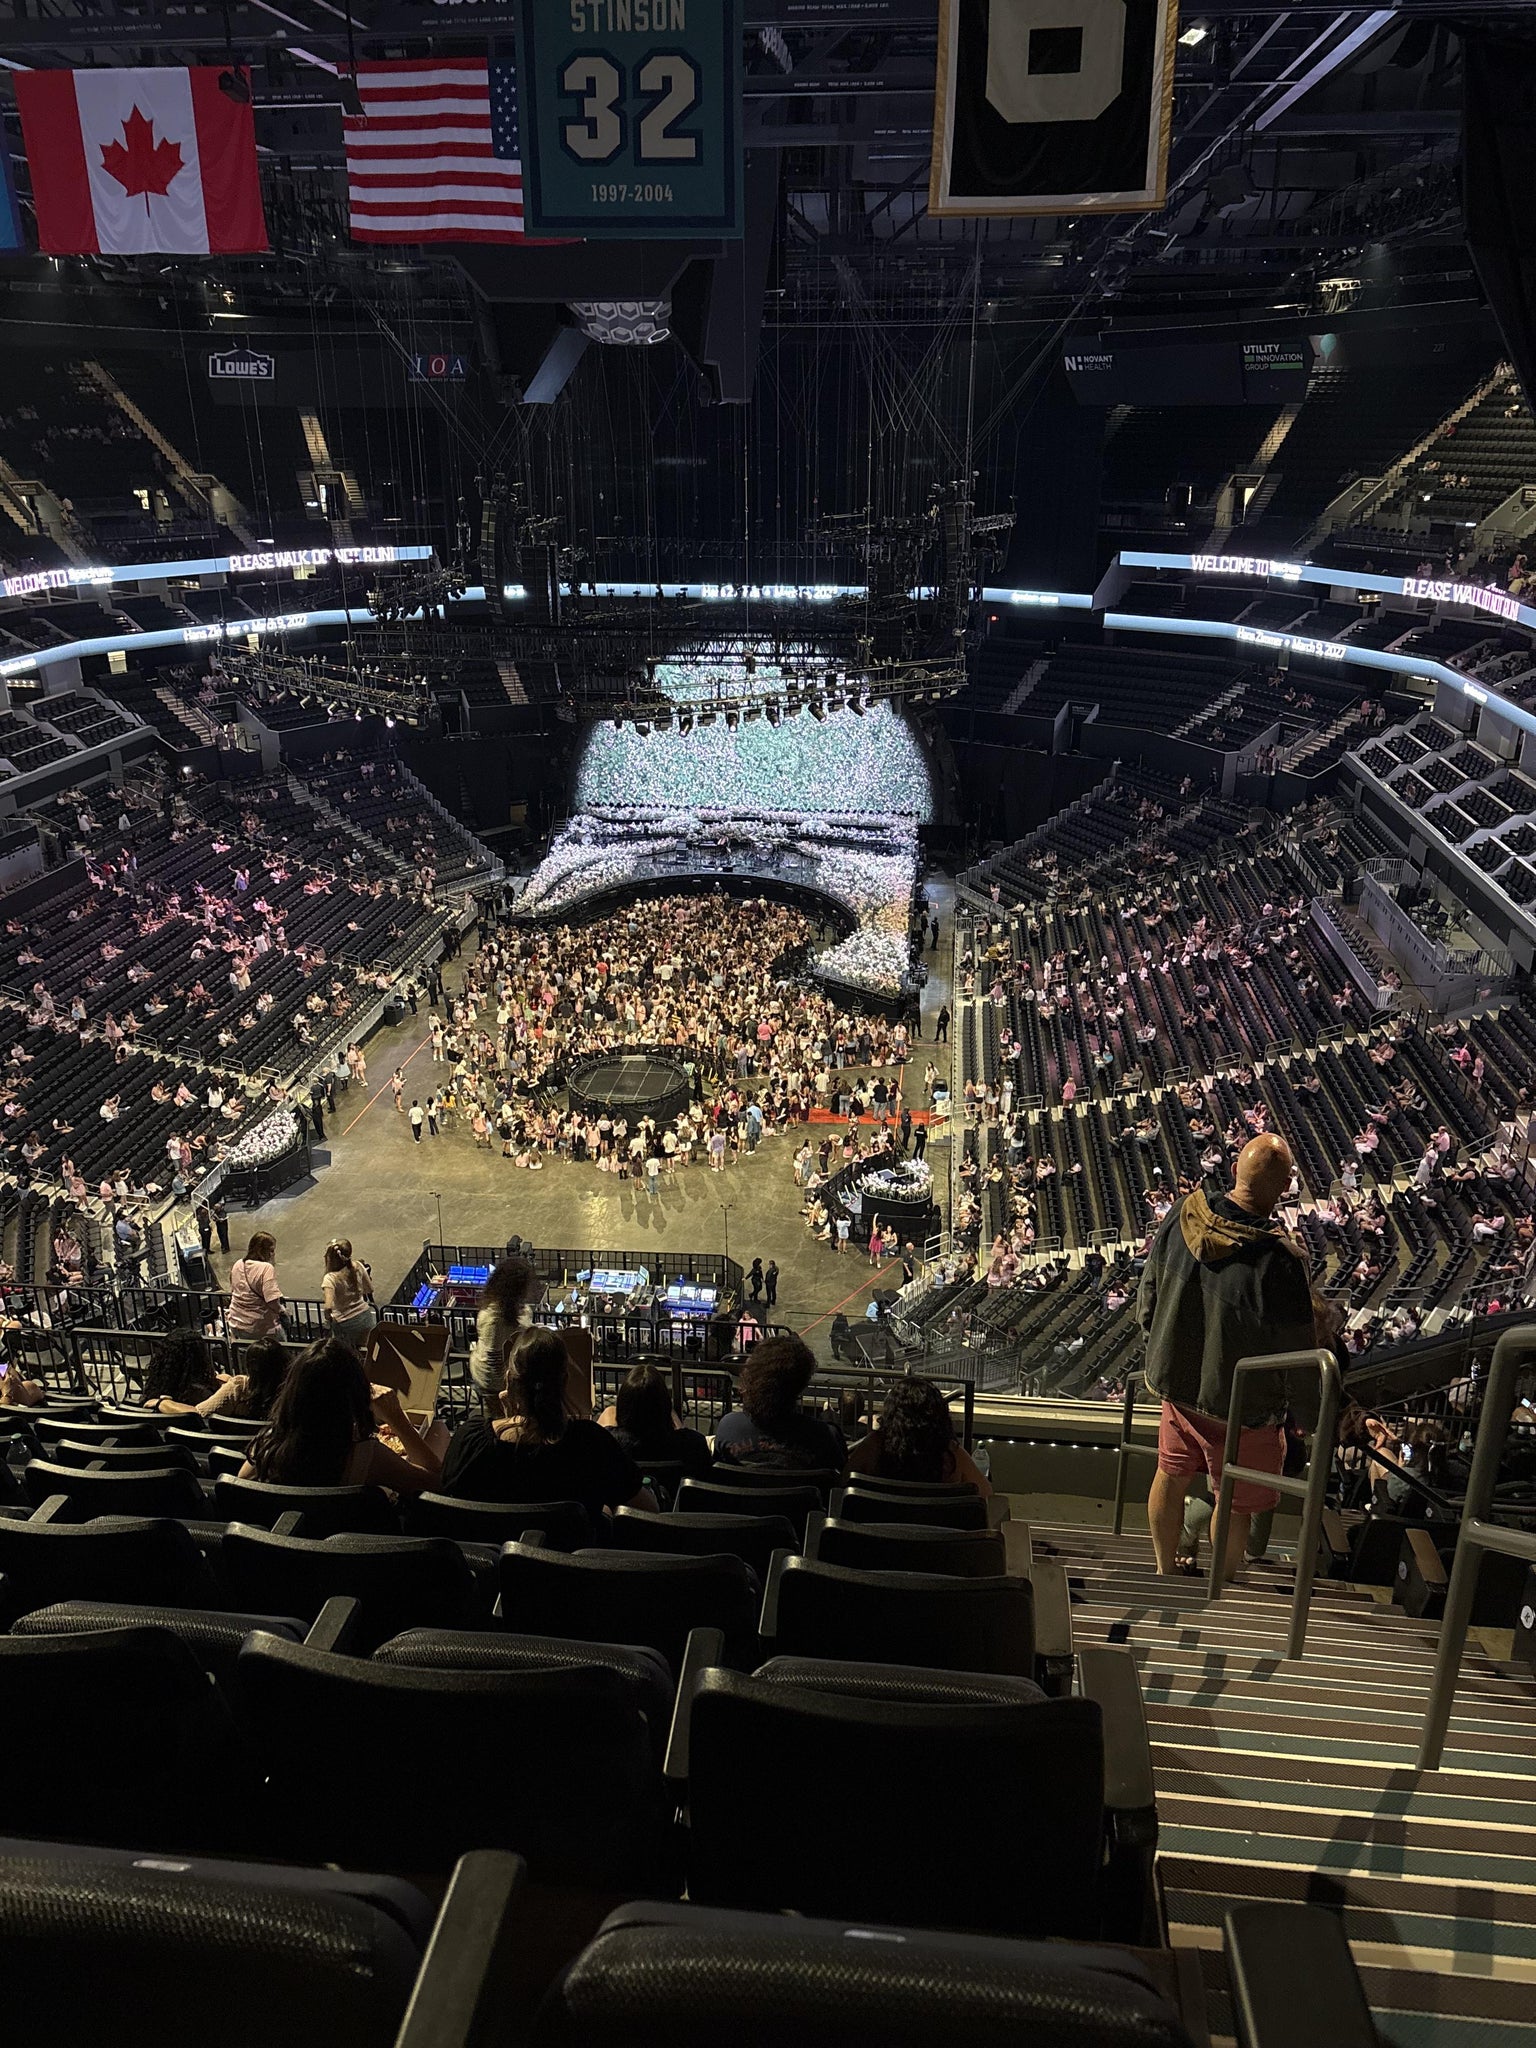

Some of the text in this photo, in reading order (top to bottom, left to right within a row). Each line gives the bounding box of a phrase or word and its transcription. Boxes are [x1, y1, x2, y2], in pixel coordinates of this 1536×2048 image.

[570, 0, 687, 33] STINSON
[563, 55, 697, 160] 32
[591, 183, 674, 203] 1997-2004
[1243, 343, 1281, 354] UTILITY
[1255, 353, 1304, 363] INNOVATION
[1083, 355, 1114, 364] NOVANT
[1084, 363, 1112, 371] HEALTH
[1244, 362, 1270, 371] GROUP
[229, 553, 274, 572] PLEASE
[1191, 555, 1255, 574] WELCOME
[3, 572, 49, 597] WELCOME
[48, 570, 68, 588] TO
[1402, 578, 1451, 602] PLEASE
